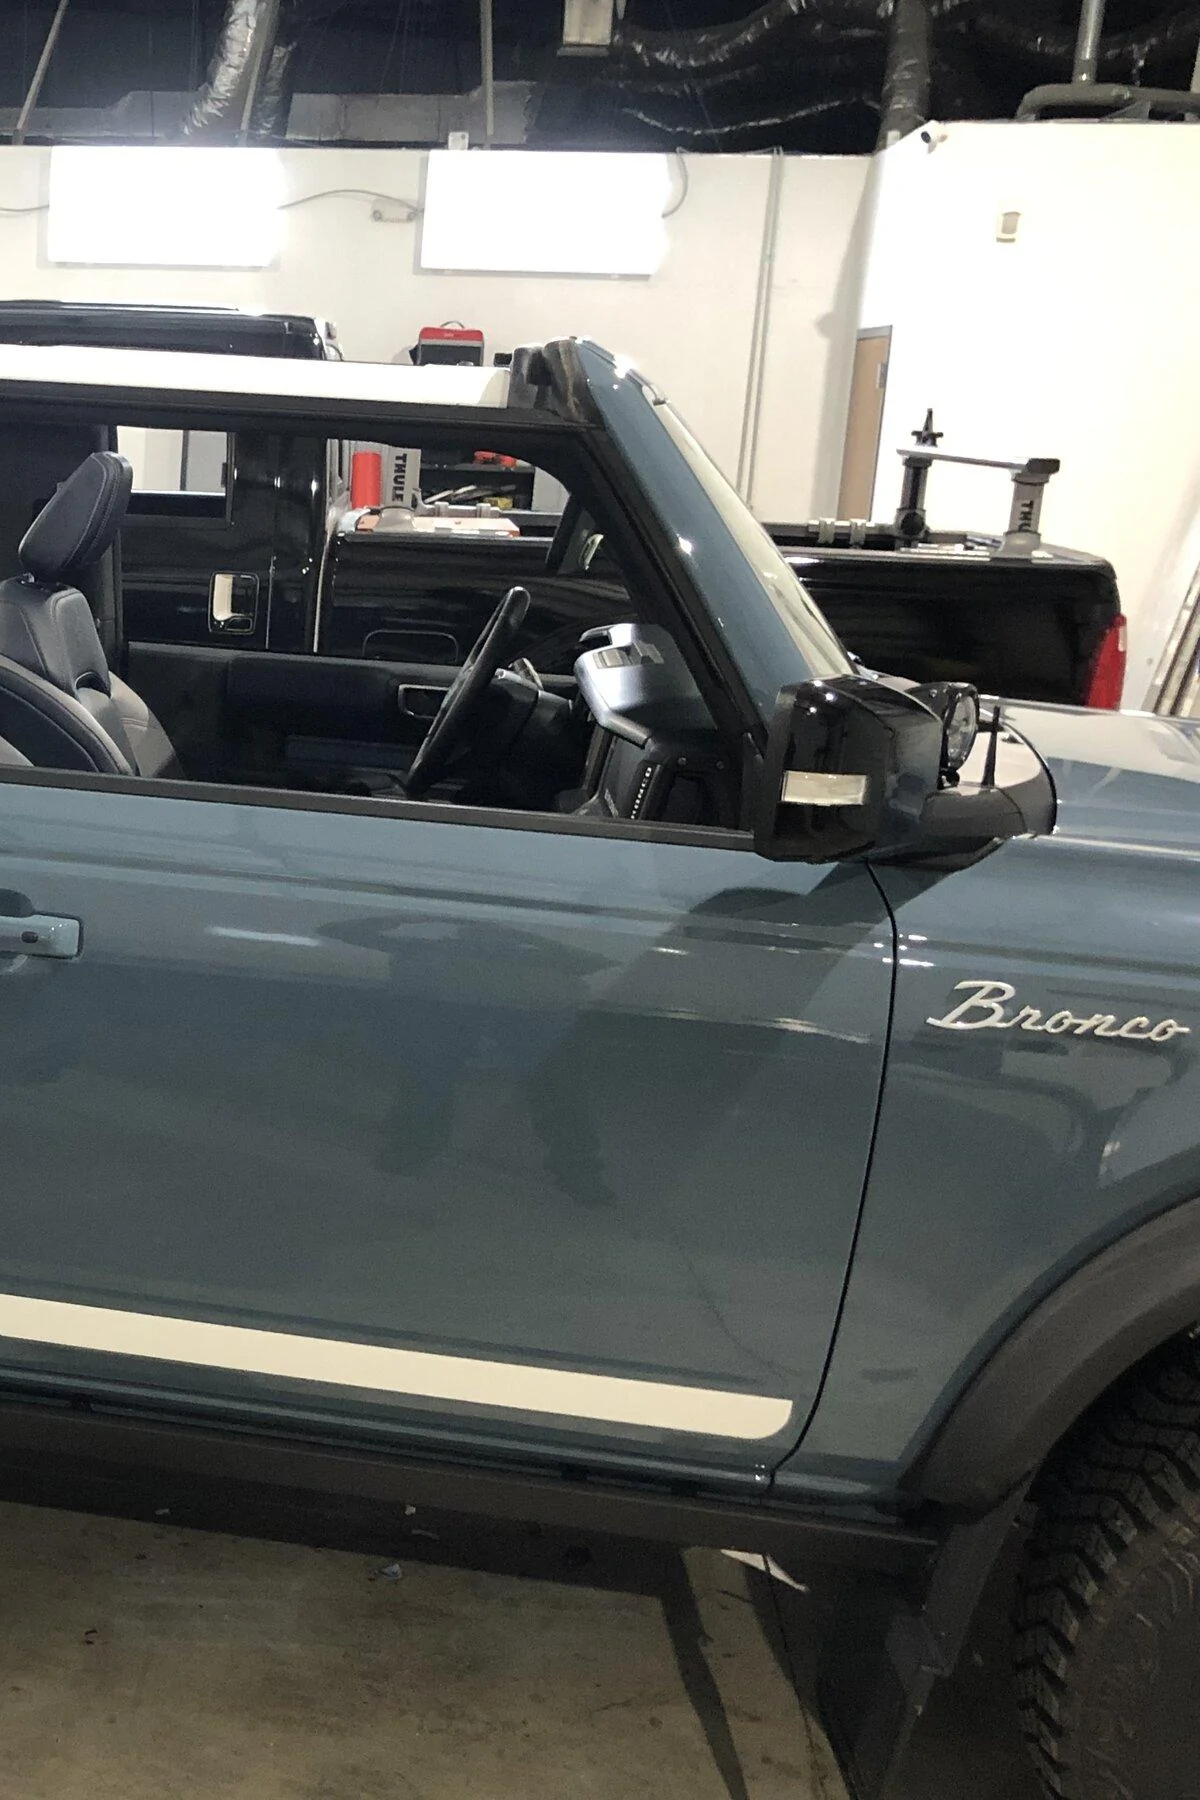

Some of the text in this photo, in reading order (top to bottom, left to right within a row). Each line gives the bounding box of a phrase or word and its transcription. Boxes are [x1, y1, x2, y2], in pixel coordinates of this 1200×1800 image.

[393, 453, 408, 502] THULE
[1018, 500, 1034, 532] THU
[926, 980, 1191, 1042] Bronco
